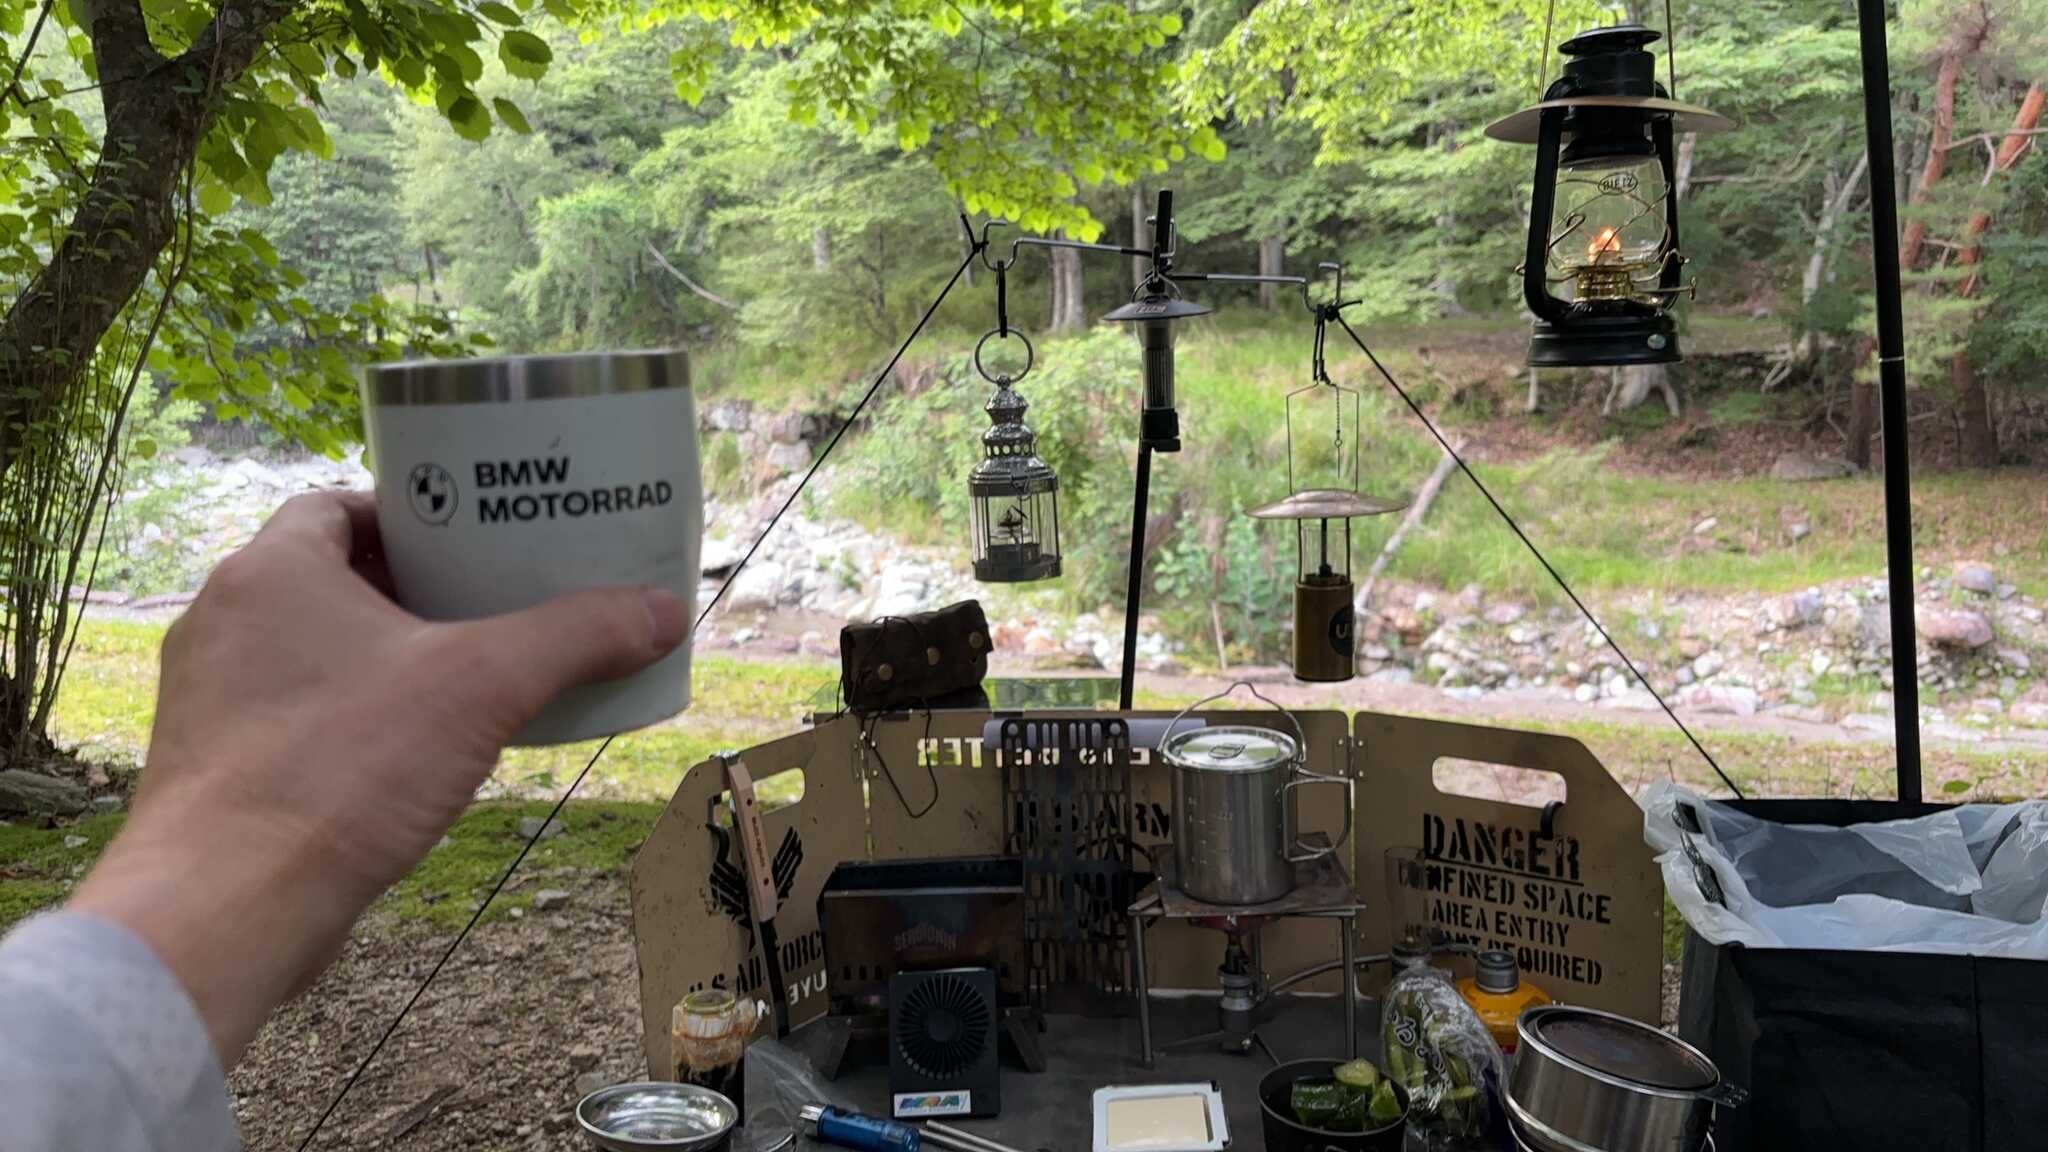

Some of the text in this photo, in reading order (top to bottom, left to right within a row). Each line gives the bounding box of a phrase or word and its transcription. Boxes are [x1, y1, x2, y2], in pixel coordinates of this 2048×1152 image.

[474, 456, 571, 488] BMW
[478, 481, 673, 524] MOTORRAD
[1423, 813, 1582, 881] DANGER
[1431, 899, 1489, 932] AREA
[1495, 911, 1570, 948] ENTRY
[1523, 880, 1612, 925] SPACE
